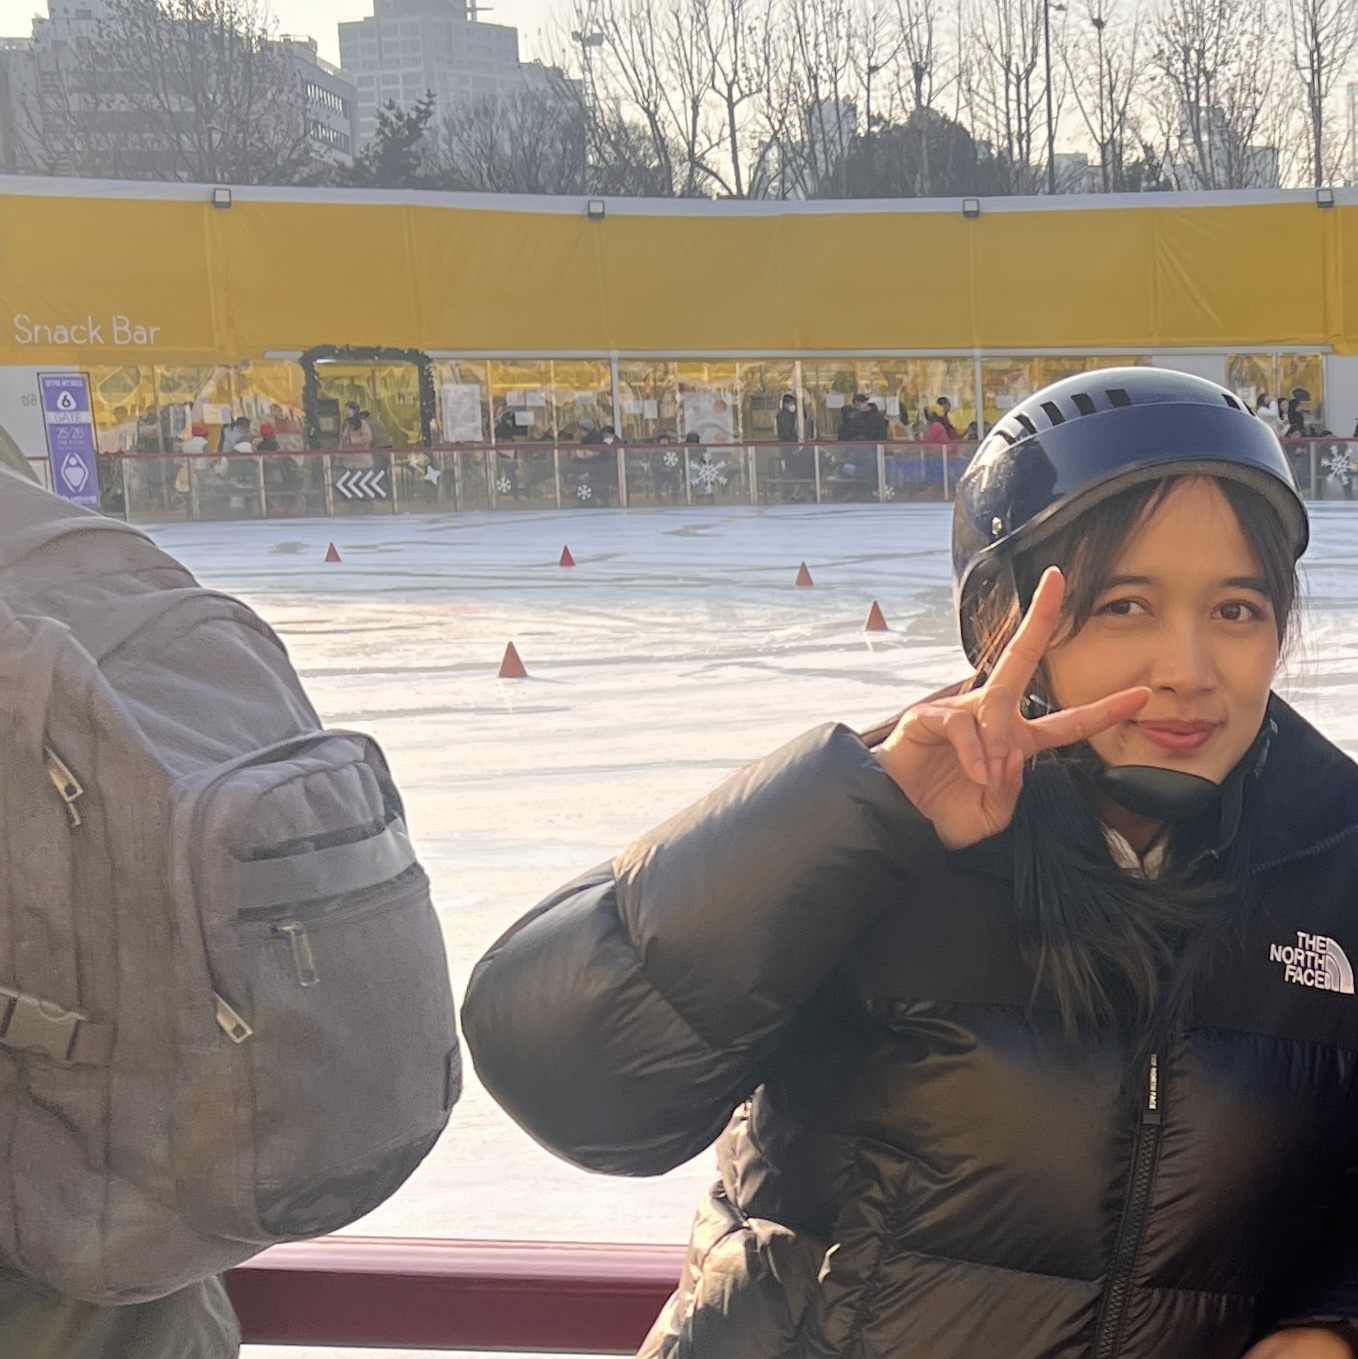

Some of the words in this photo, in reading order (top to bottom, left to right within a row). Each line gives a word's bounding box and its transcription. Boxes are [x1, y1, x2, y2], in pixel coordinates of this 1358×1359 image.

[13, 313, 105, 345] Snack
[112, 314, 161, 345] Bar
[61, 394, 71, 408] 6
[54, 411, 81, 422] GATE
[1296, 931, 1327, 954] THE
[1269, 943, 1326, 971] NORTH
[1284, 964, 1326, 990] FACE
